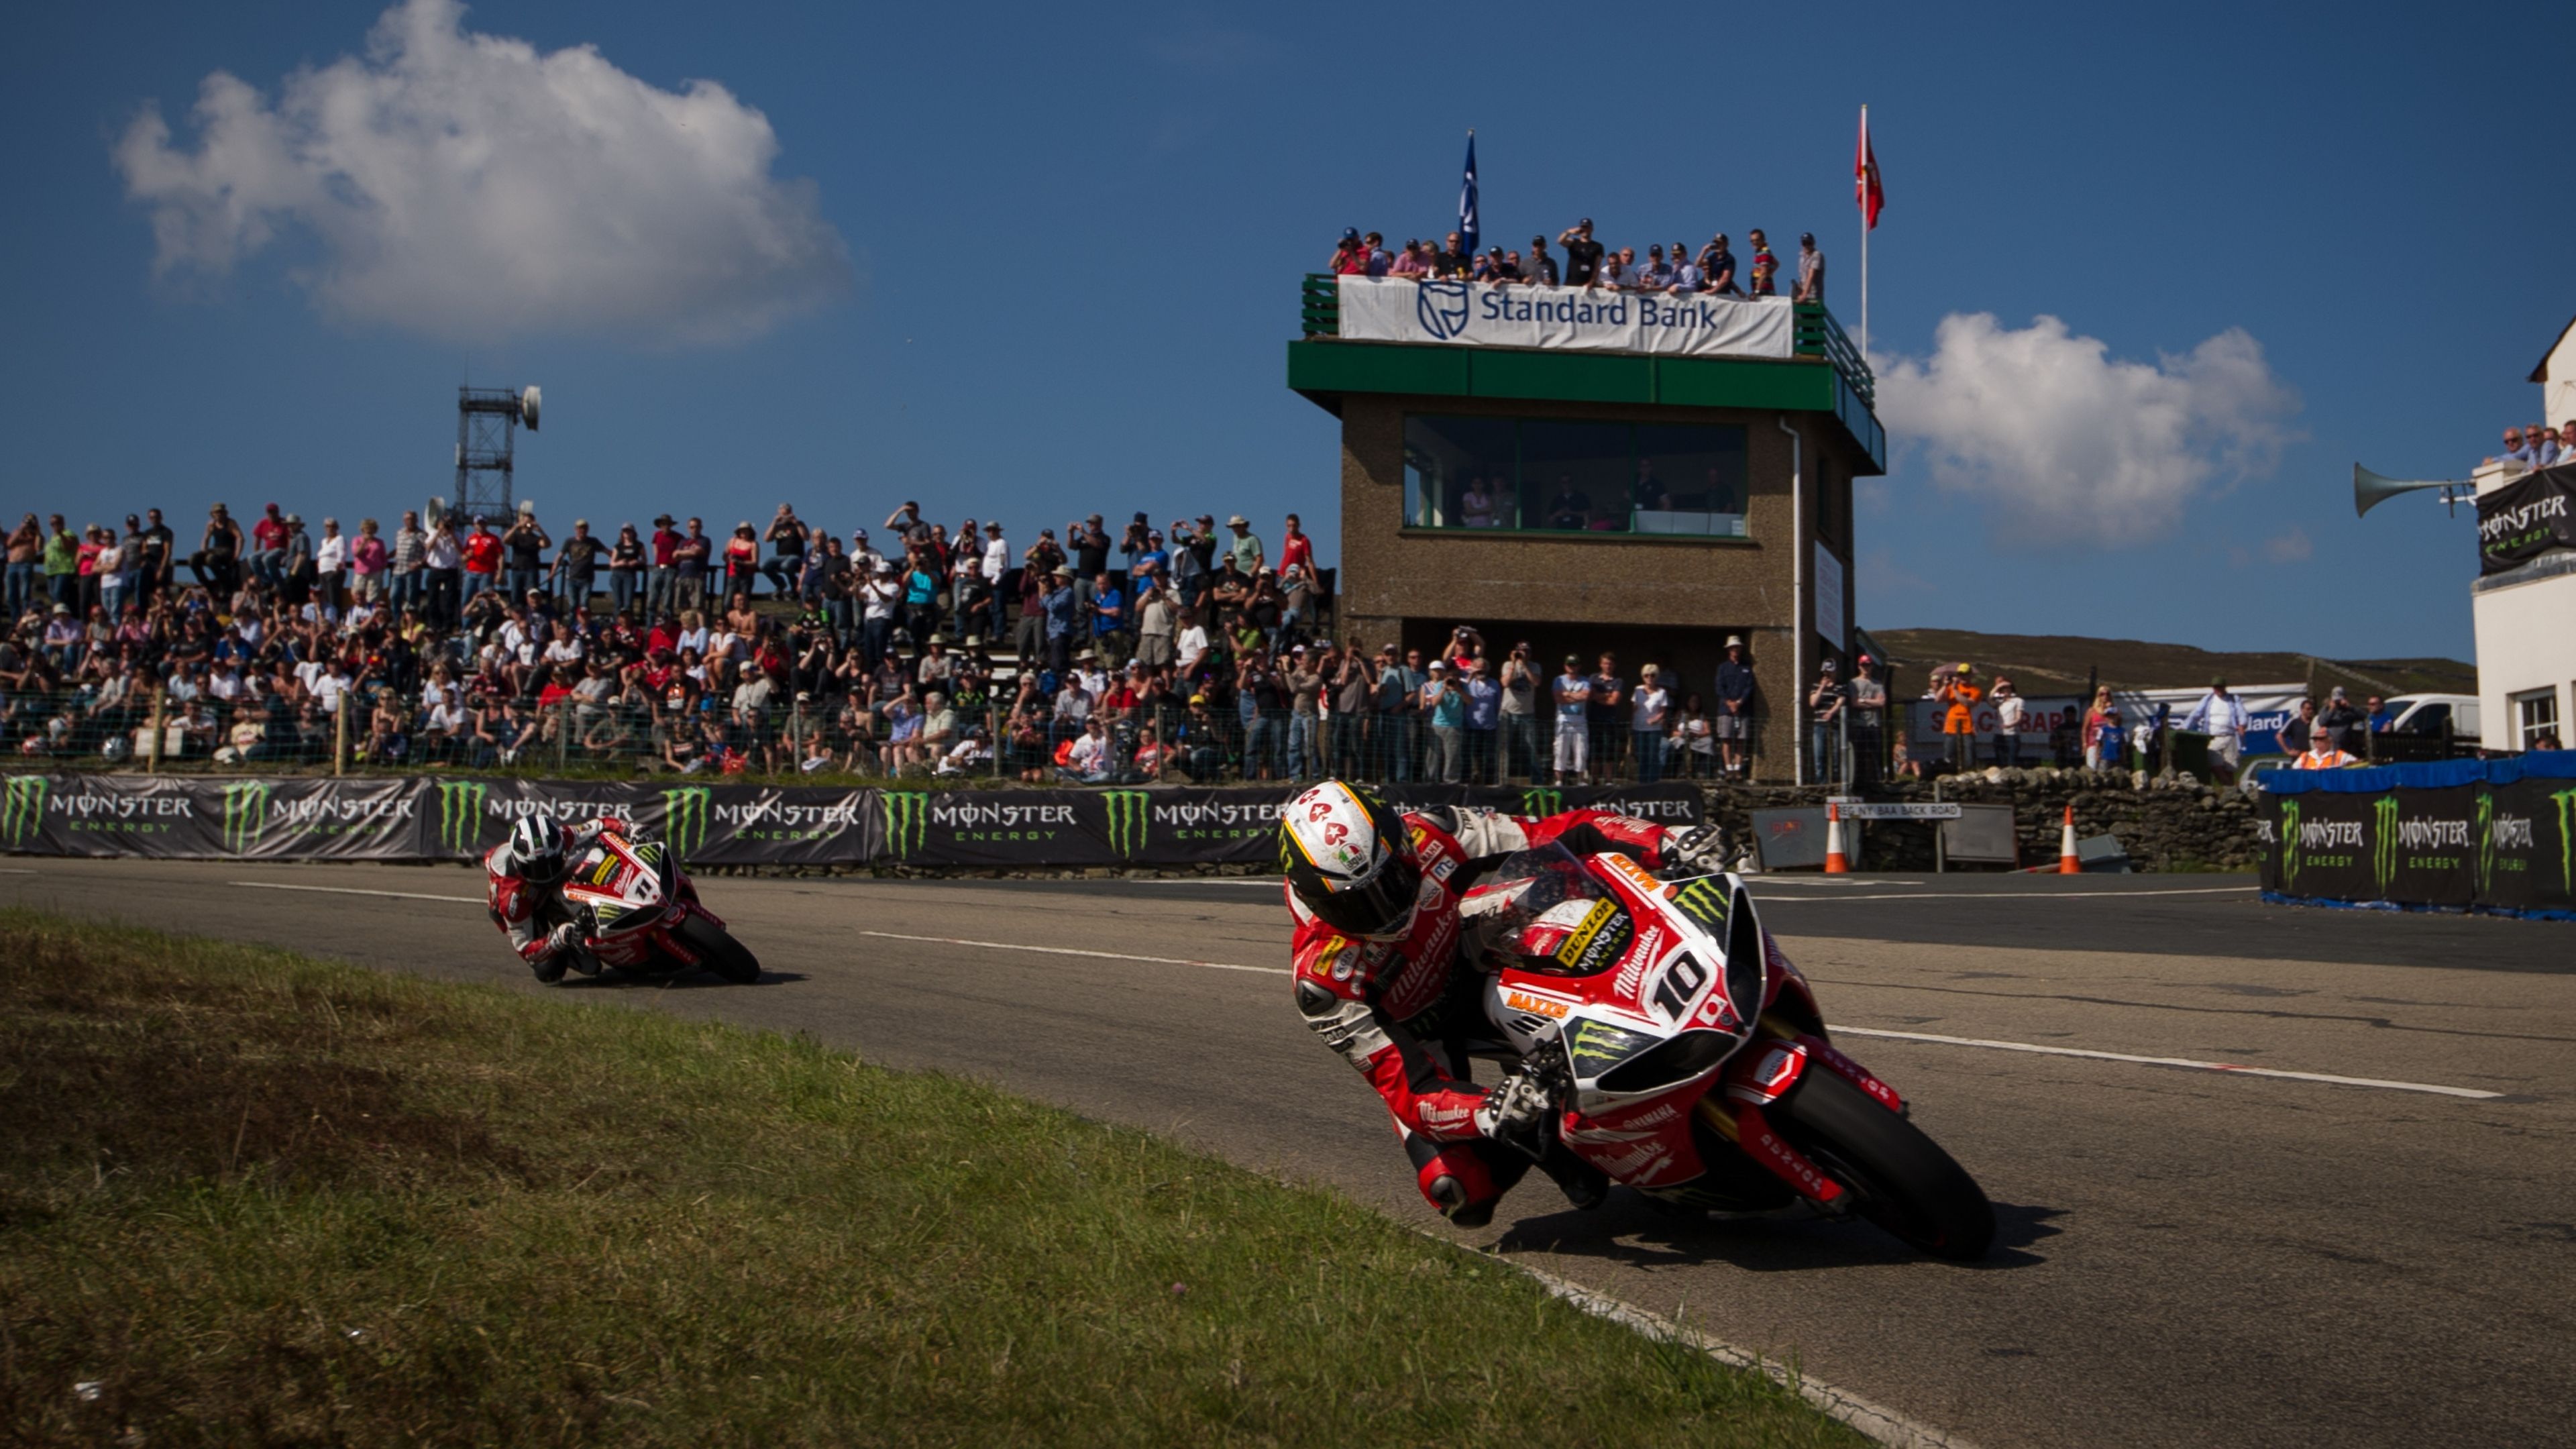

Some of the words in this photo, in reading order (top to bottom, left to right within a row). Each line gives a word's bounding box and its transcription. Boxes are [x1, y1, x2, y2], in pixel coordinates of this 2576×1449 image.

[1481, 291, 1627, 326] Standard
[1641, 298, 1717, 330] Bank
[50, 793, 193, 818] MONSTER
[273, 793, 414, 820] MONSTER
[489, 797, 633, 821] MONSTER
[716, 802, 859, 824] MONSTER
[932, 802, 1077, 827] MONSTER
[1835, 806, 1854, 815] REG
[1901, 806, 1926, 814] BACK
[1931, 806, 1957, 814] ROAD
[70, 822, 171, 833] ENERGY
[292, 824, 392, 836] ENERGY
[737, 830, 835, 840] ENERGY
[956, 830, 1056, 841] ENERGY
[1177, 828, 1275, 839] ENERGY
[2300, 816, 2364, 847] MONSTER
[2398, 815, 2470, 848] MONSTER
[2306, 855, 2353, 867] ENERGY
[2409, 857, 2460, 869] ENERGY
[635, 878, 653, 899] 11
[1564, 902, 1613, 963] DUNLOP
[1578, 912, 1629, 971] MONSTER
[1595, 924, 1631, 968] ENERGY
[1612, 923, 1661, 1000] Milwaukee
[1654, 950, 1707, 1024] 10
[1507, 992, 1570, 1019] MAXXIS
